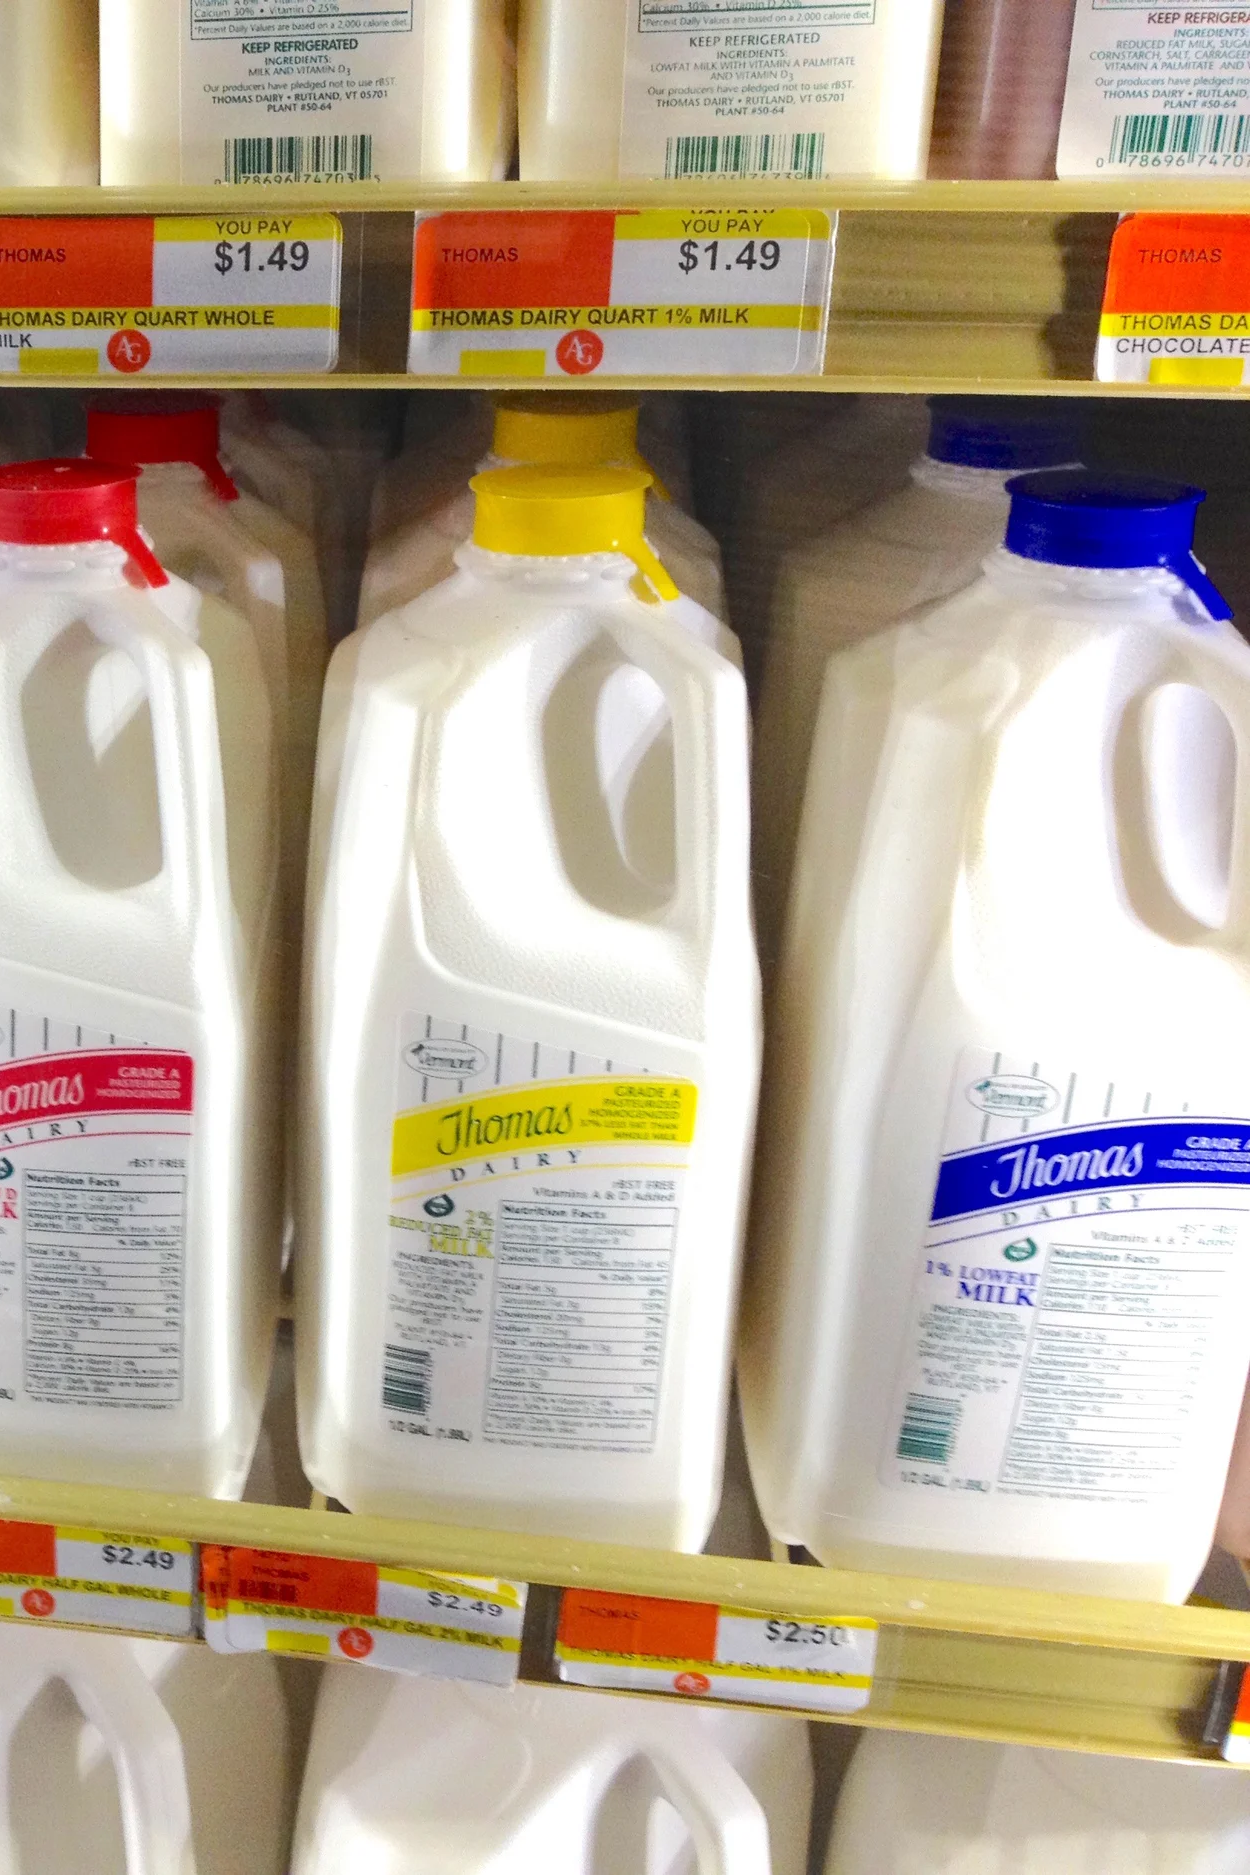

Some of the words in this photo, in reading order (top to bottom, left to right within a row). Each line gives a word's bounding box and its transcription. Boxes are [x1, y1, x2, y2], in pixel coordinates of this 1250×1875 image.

[1148, 12, 1180, 24] KEEP
[690, 36, 721, 47] KEEP
[725, 32, 820, 46] REFRIGERATED
[1174, 29, 1249, 38] INGREDIENTS:
[242, 42, 270, 54] KEEP
[274, 39, 358, 53] REFRIGERATED
[1116, 40, 1165, 49] REDUCED
[1168, 40, 1185, 48] FAT
[265, 55, 331, 66] INGREDIENTS:
[717, 49, 787, 59] INGREDIENTS:
[1090, 52, 1162, 61] CORNSTARCH,
[1163, 100, 1198, 109] PLANT
[215, 221, 252, 235] YOU
[258, 221, 292, 234] PAY
[681, 219, 720, 233] YOU
[727, 219, 763, 233] PAY
[214, 240, 309, 276] $1.49
[442, 248, 519, 263] THOMAS
[678, 240, 780, 274] $1.49
[1139, 248, 1222, 264] THOMAS
[72, 312, 128, 326] DAIRY
[134, 311, 198, 326] QUART
[205, 311, 274, 326] WHOLE
[429, 310, 513, 326] THOMAS
[520, 309, 580, 325] DAIRY
[587, 309, 658, 325] QUART
[665, 309, 692, 324] 1%
[699, 308, 749, 324] MILK
[1120, 315, 1211, 330] THOMAS
[1116, 338, 1250, 353] CHOCOLATE
[118, 1067, 166, 1079] GRADE
[614, 1087, 665, 1099] GRADE
[671, 1087, 681, 1098] A
[437, 1102, 573, 1155] Thomas
[1185, 1136, 1242, 1150] GRADE
[450, 1150, 582, 1182] DAIRY
[990, 1142, 1144, 1199] Thomas
[27, 1174, 85, 1186] Nutrition
[89, 1176, 120, 1188] Facts
[1001, 1193, 1147, 1226] DAIRY
[956, 1281, 1037, 1307] MILK
[102, 1545, 174, 1570] $2.49
[427, 1591, 503, 1617] $2.49
